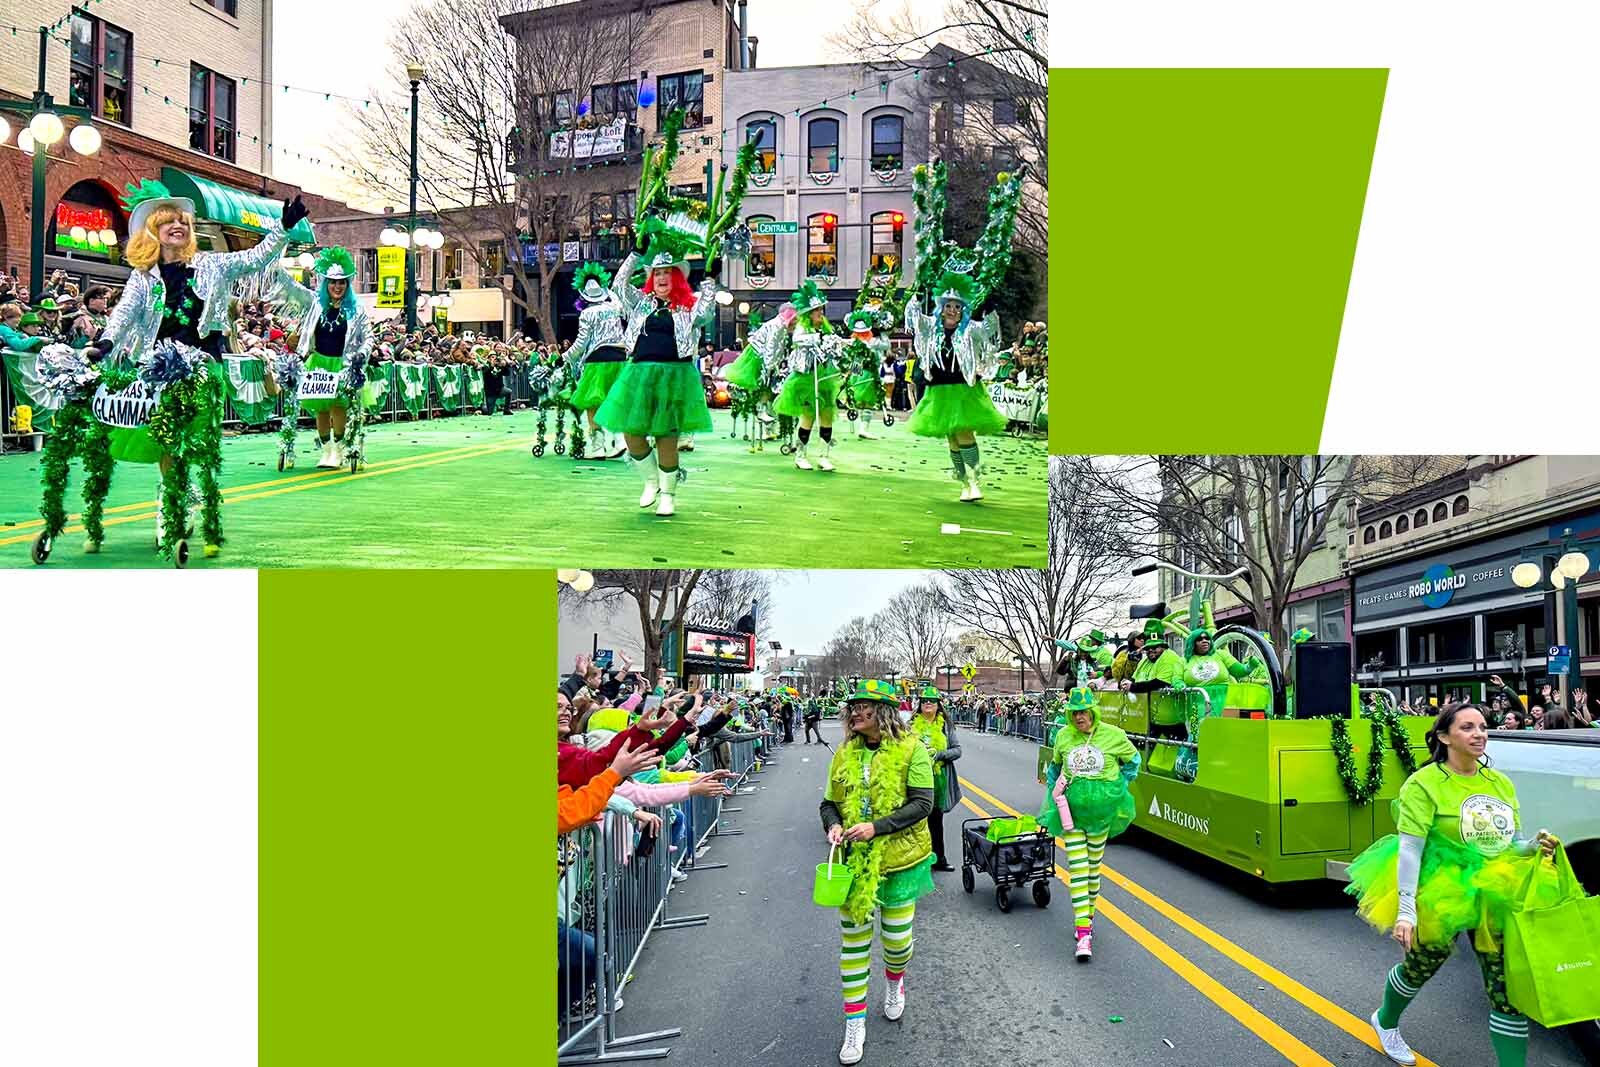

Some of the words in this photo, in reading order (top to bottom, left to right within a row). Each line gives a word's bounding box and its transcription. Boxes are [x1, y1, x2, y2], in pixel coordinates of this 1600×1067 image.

[604, 126, 622, 137] Loft
[760, 223, 787, 233] CENTRAL
[312, 372, 328, 382] TEXAS
[301, 382, 336, 395] GLAMMAS
[991, 395, 1032, 407] GLAMMAS
[1359, 594, 1381, 606] TREATS
[1384, 589, 1407, 601] GAMES
[1408, 581, 1432, 599] ROBO
[1433, 573, 1466, 592] WORLD
[1472, 567, 1503, 582] COFFEE
[689, 612, 730, 630] Malco
[1163, 802, 1209, 835] REGIONS
